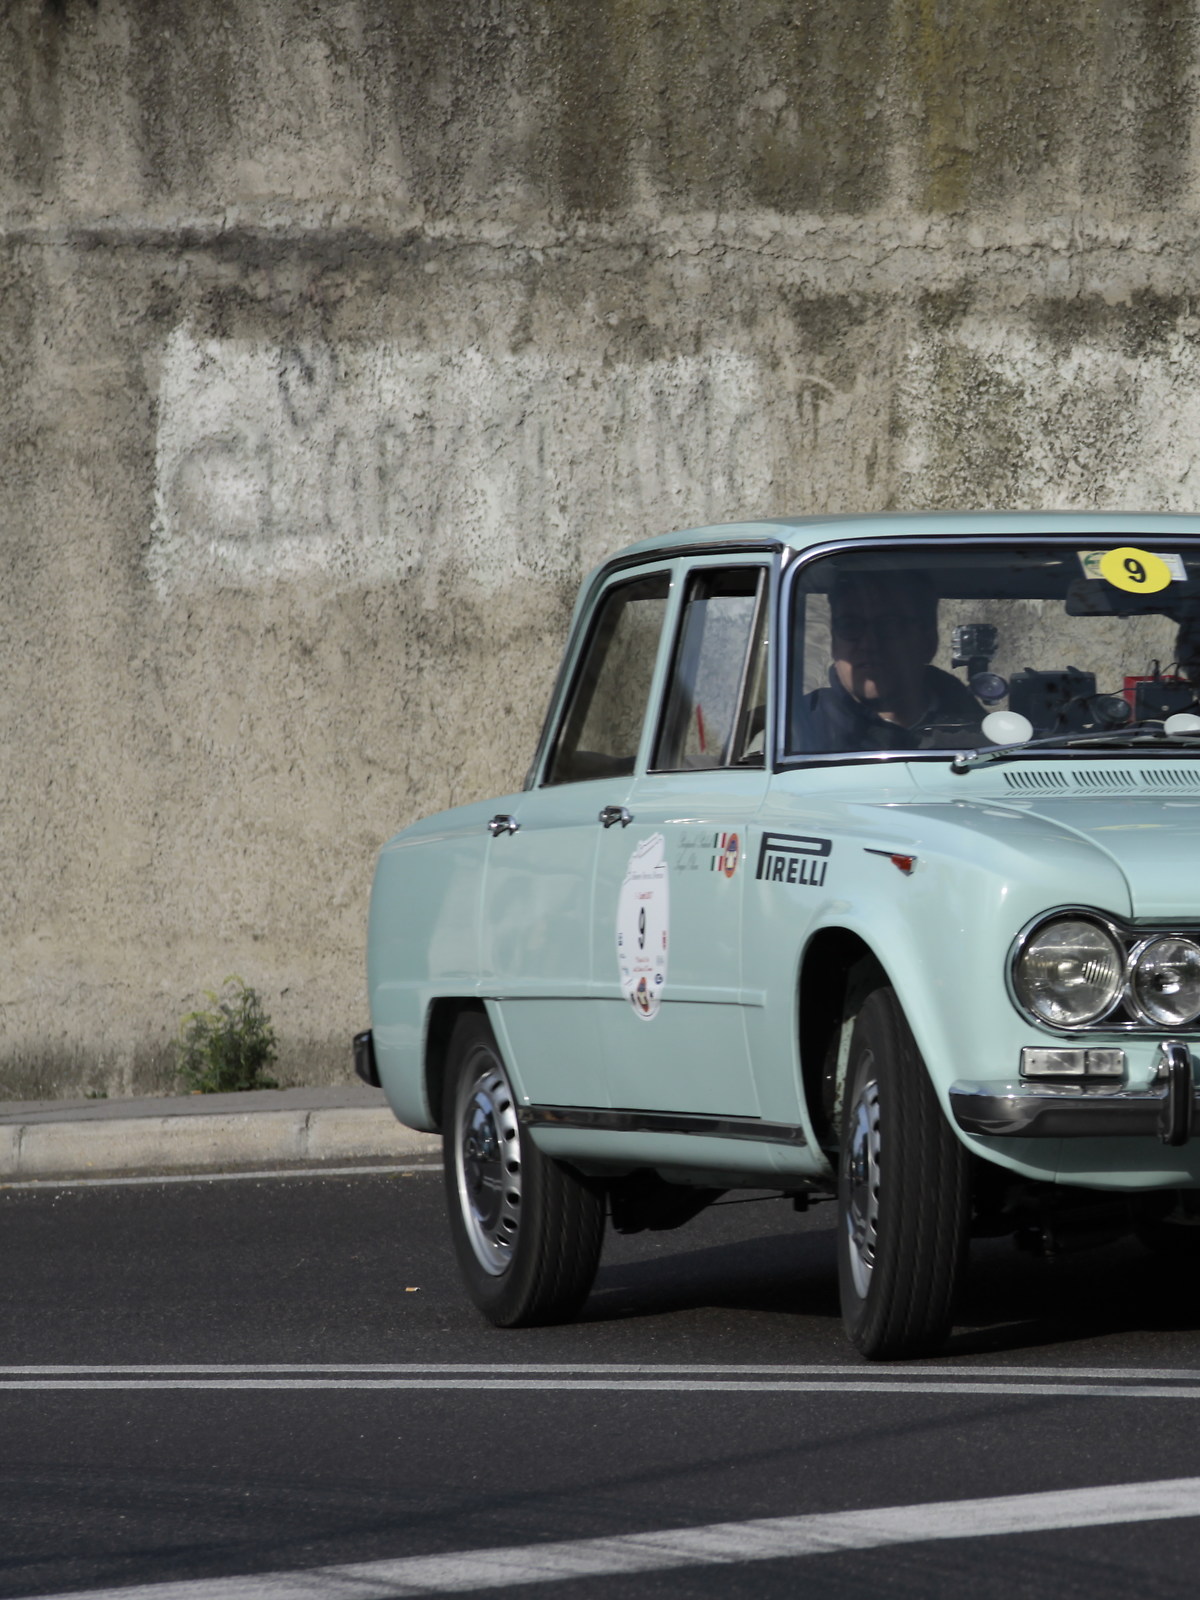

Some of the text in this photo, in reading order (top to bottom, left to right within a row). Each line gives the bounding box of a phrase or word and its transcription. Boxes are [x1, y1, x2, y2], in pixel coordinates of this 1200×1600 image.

[1123, 558, 1147, 583] 9
[755, 831, 833, 887] PIRELLI
[638, 907, 646, 950] 9
